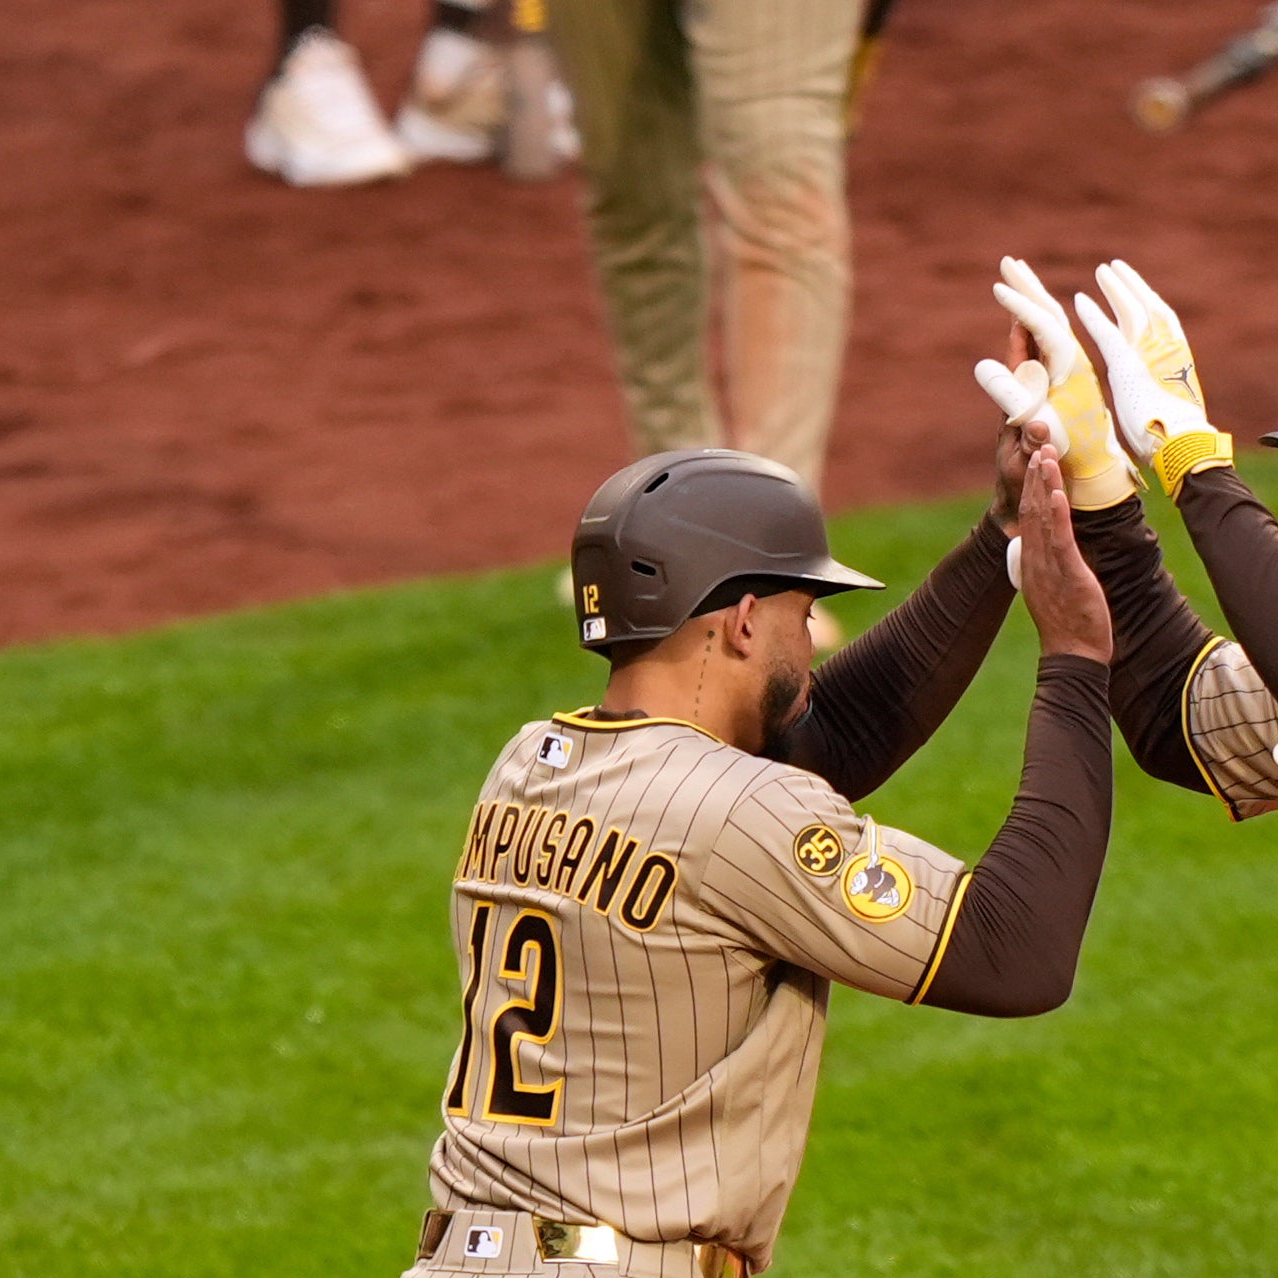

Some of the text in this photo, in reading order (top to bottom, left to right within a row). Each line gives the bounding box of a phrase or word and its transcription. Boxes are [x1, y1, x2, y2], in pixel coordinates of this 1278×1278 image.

[583, 584, 600, 614] 12
[455, 799, 679, 933] MPUSANO
[799, 829, 839, 871] 35
[447, 900, 564, 1127] 12
